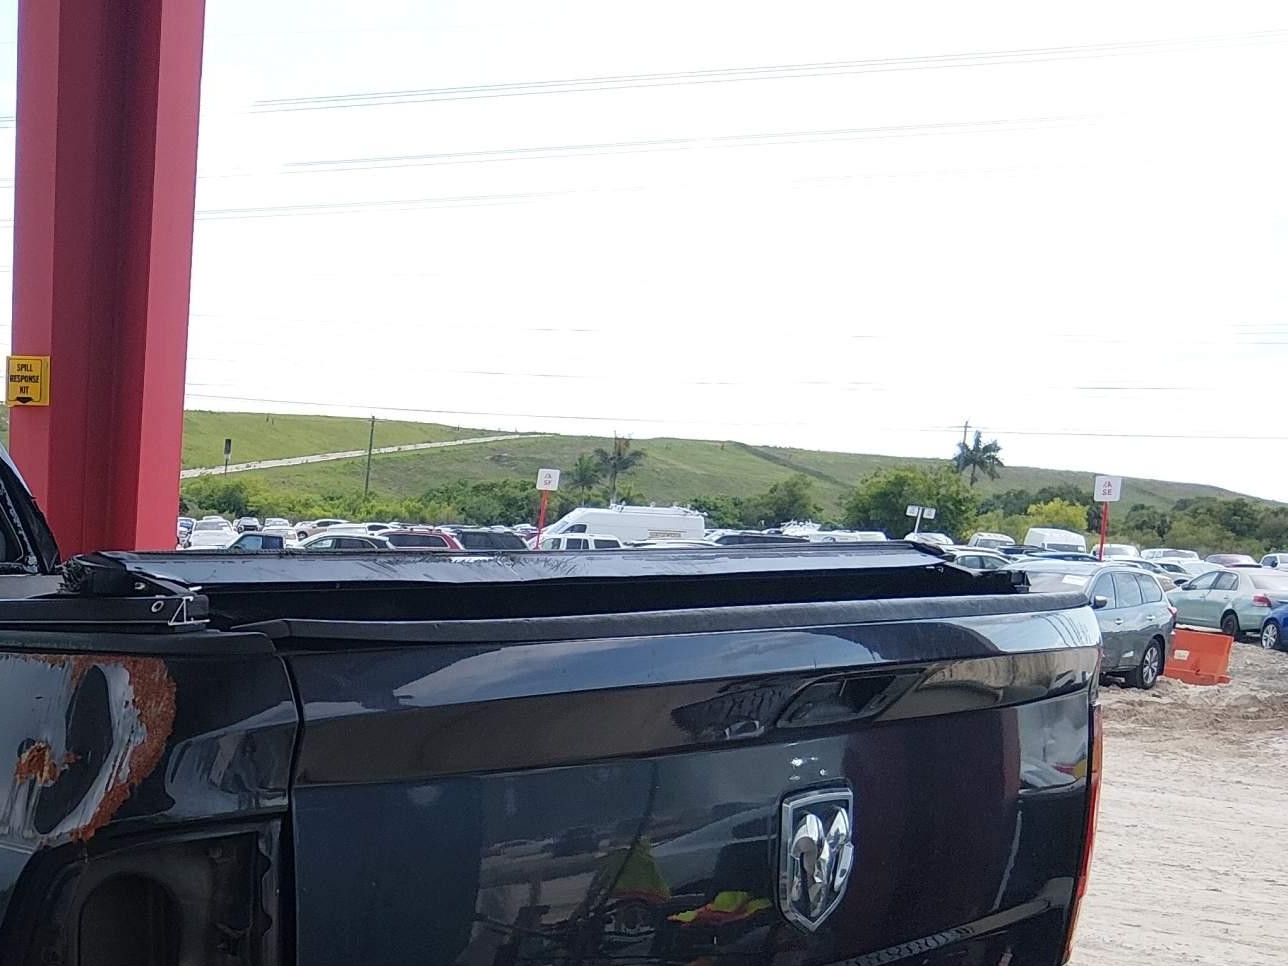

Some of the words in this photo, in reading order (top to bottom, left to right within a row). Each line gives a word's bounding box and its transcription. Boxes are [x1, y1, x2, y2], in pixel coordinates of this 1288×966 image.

[16, 363, 33, 372] SPILL
[9, 374, 40, 383] RESPONSE
[19, 386, 29, 394] KIT
